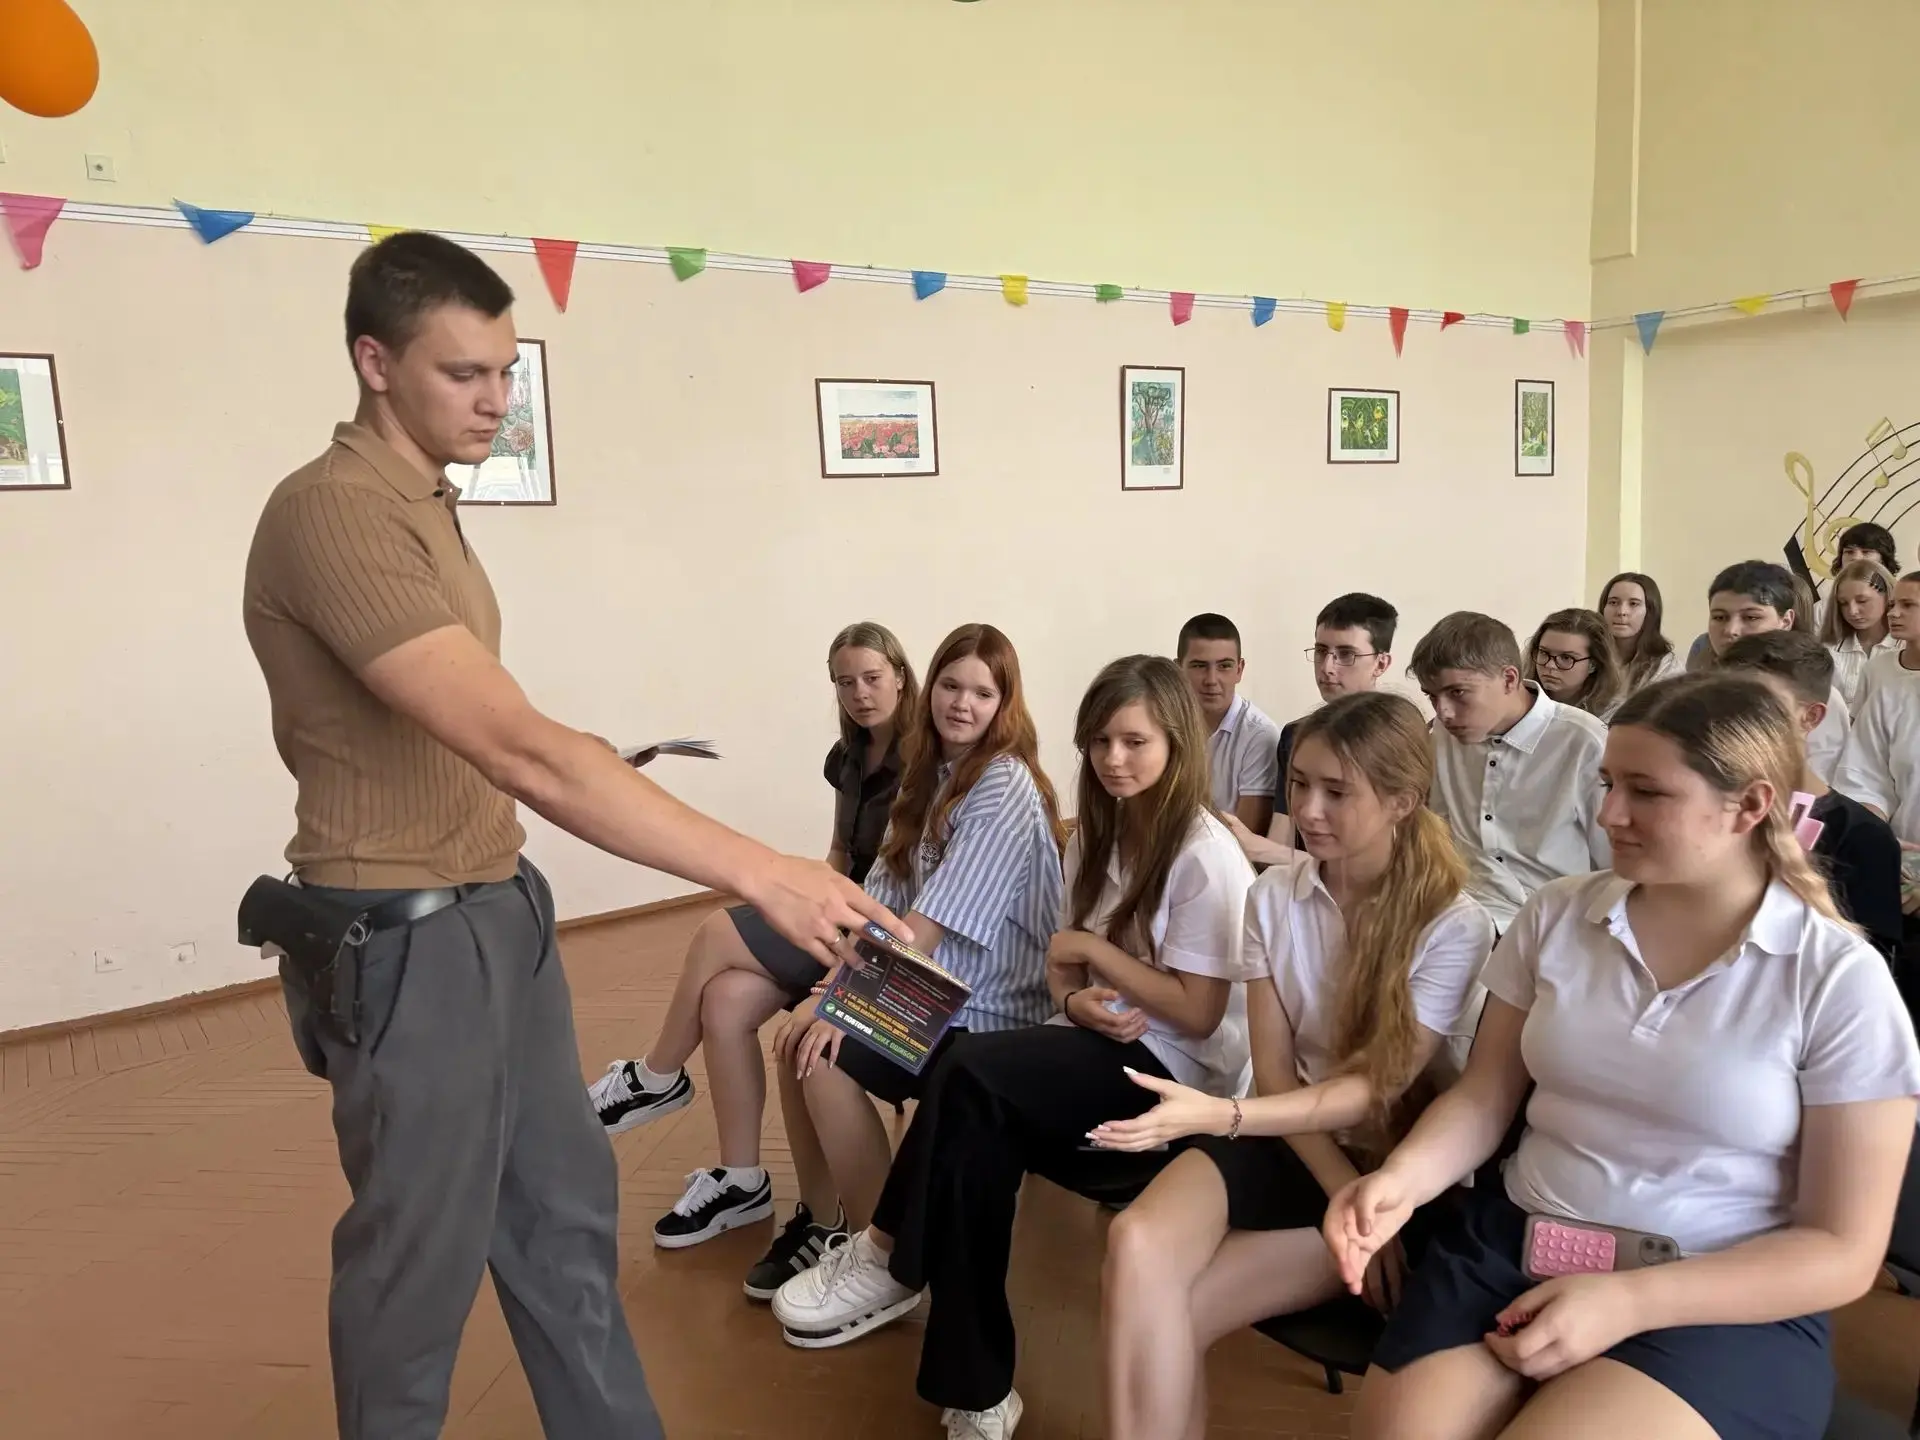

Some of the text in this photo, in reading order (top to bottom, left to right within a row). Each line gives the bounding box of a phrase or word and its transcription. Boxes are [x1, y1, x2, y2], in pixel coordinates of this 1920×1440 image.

[835, 1010, 844, 1018] НЕ
[843, 1015, 872, 1035] ПОВТОРЯЙ
[890, 1043, 917, 1062] ОШИБОК!
